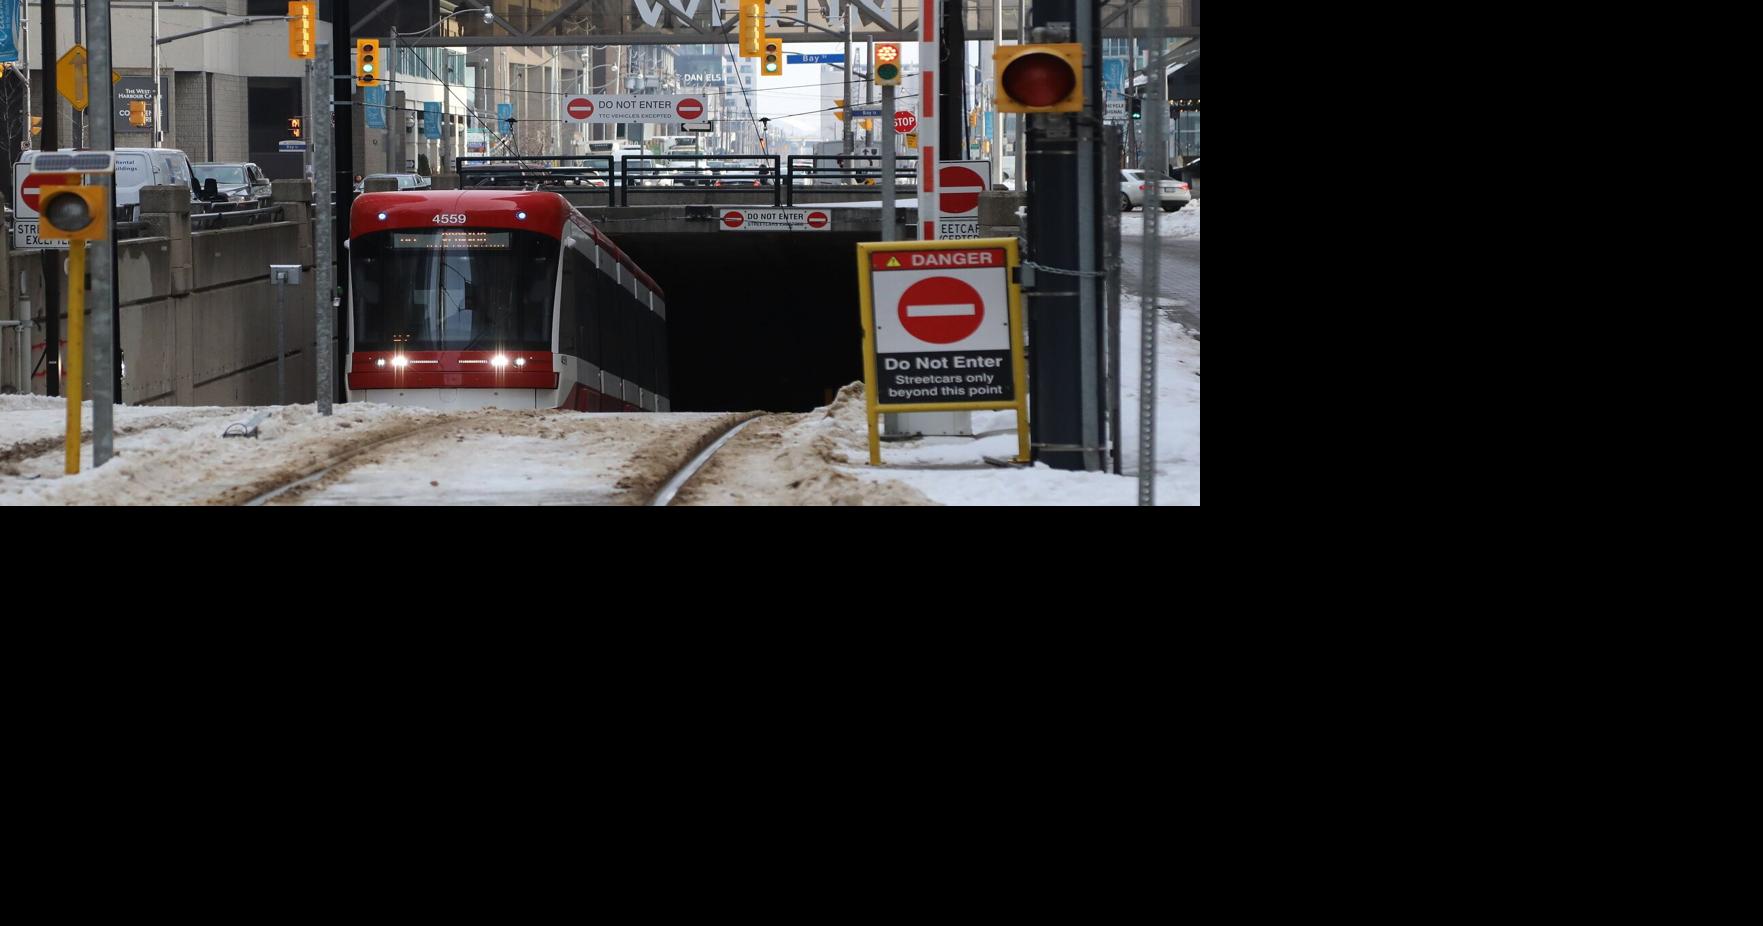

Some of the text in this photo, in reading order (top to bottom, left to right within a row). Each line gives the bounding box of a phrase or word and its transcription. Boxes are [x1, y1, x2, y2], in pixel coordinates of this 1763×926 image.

[802, 54, 820, 63] Bay
[598, 100, 672, 109] DO NOT ENTER
[893, 116, 915, 127] STOP
[432, 214, 467, 224] 4559
[911, 252, 993, 266] DANGER
[885, 355, 1003, 371] Do Not Enter
[895, 372, 994, 385] Streetcars only
[888, 384, 1003, 399] beyond this point
